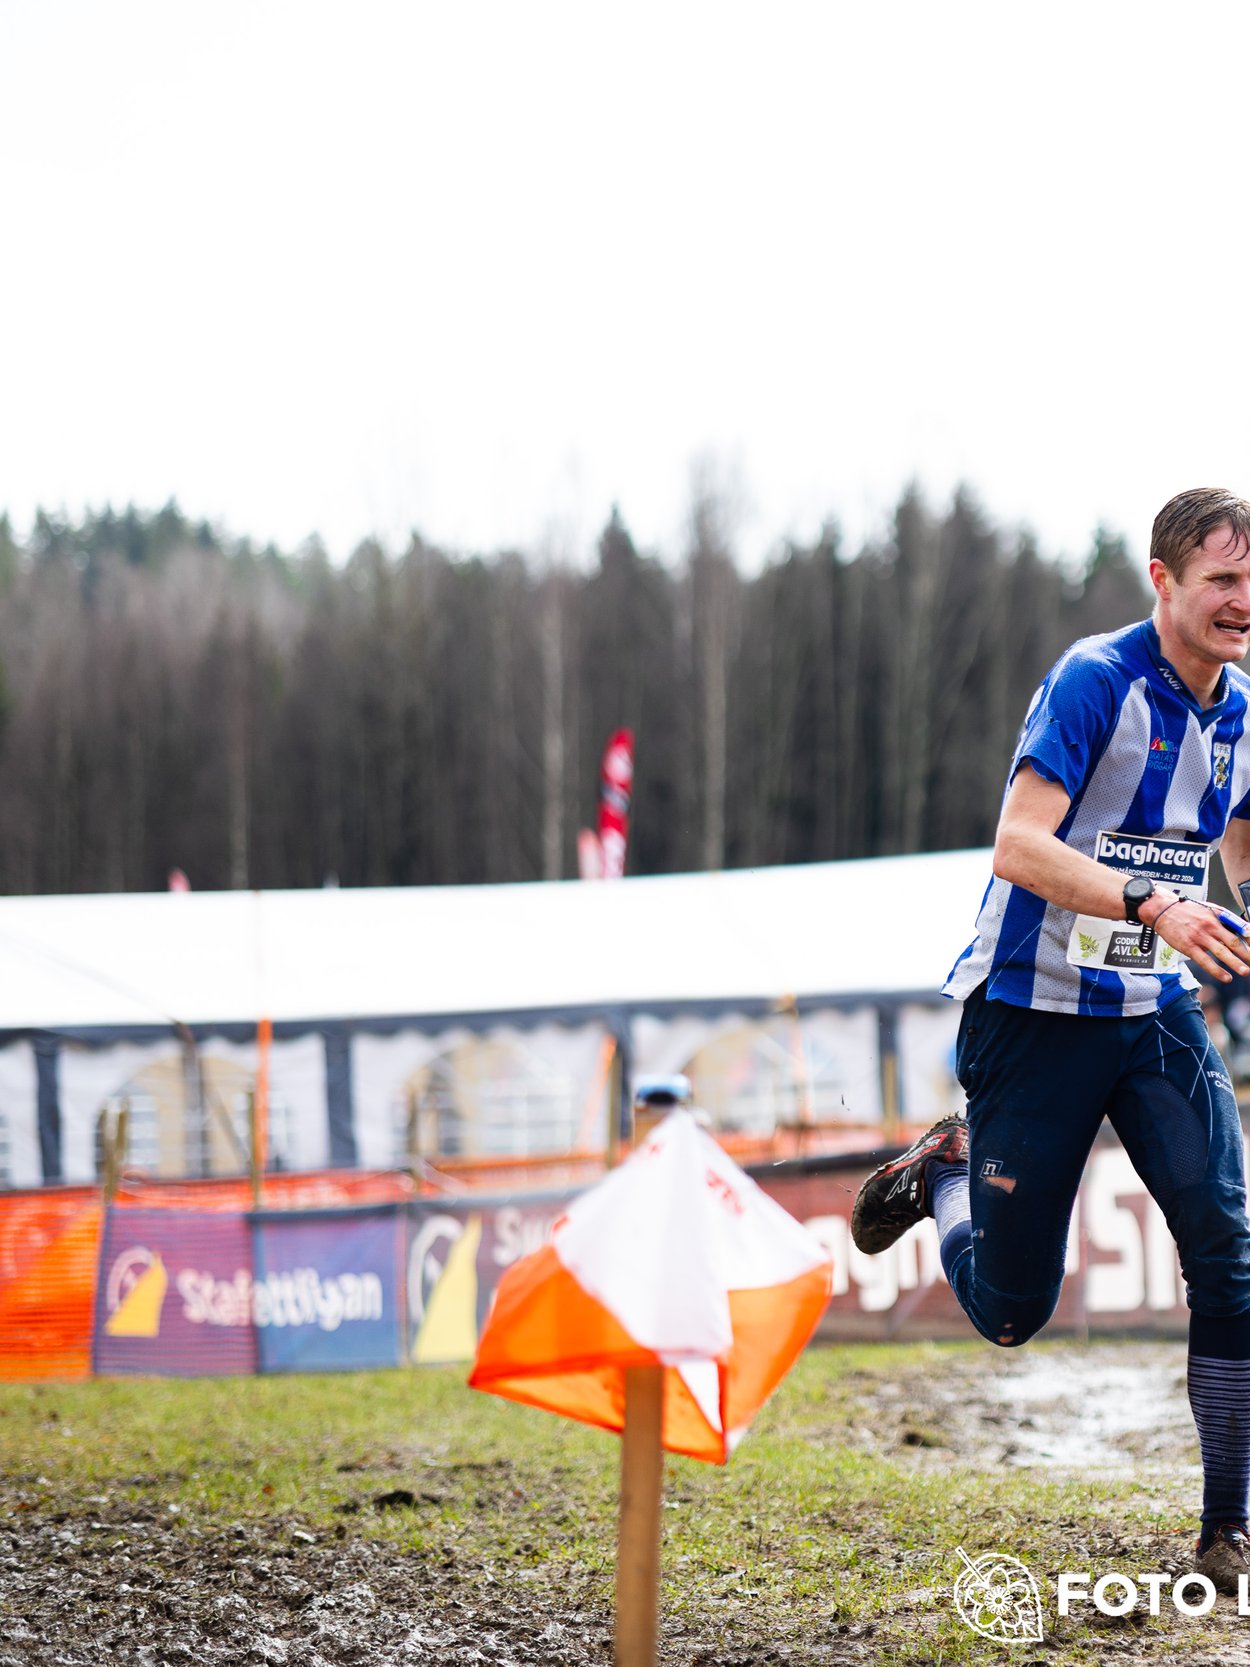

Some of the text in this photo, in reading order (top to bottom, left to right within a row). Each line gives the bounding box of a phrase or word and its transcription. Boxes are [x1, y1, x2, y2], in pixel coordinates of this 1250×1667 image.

[1100, 836, 1206, 869] bagheera
[1164, 872, 1171, 880] SL
[1180, 875, 1195, 883] 2026
